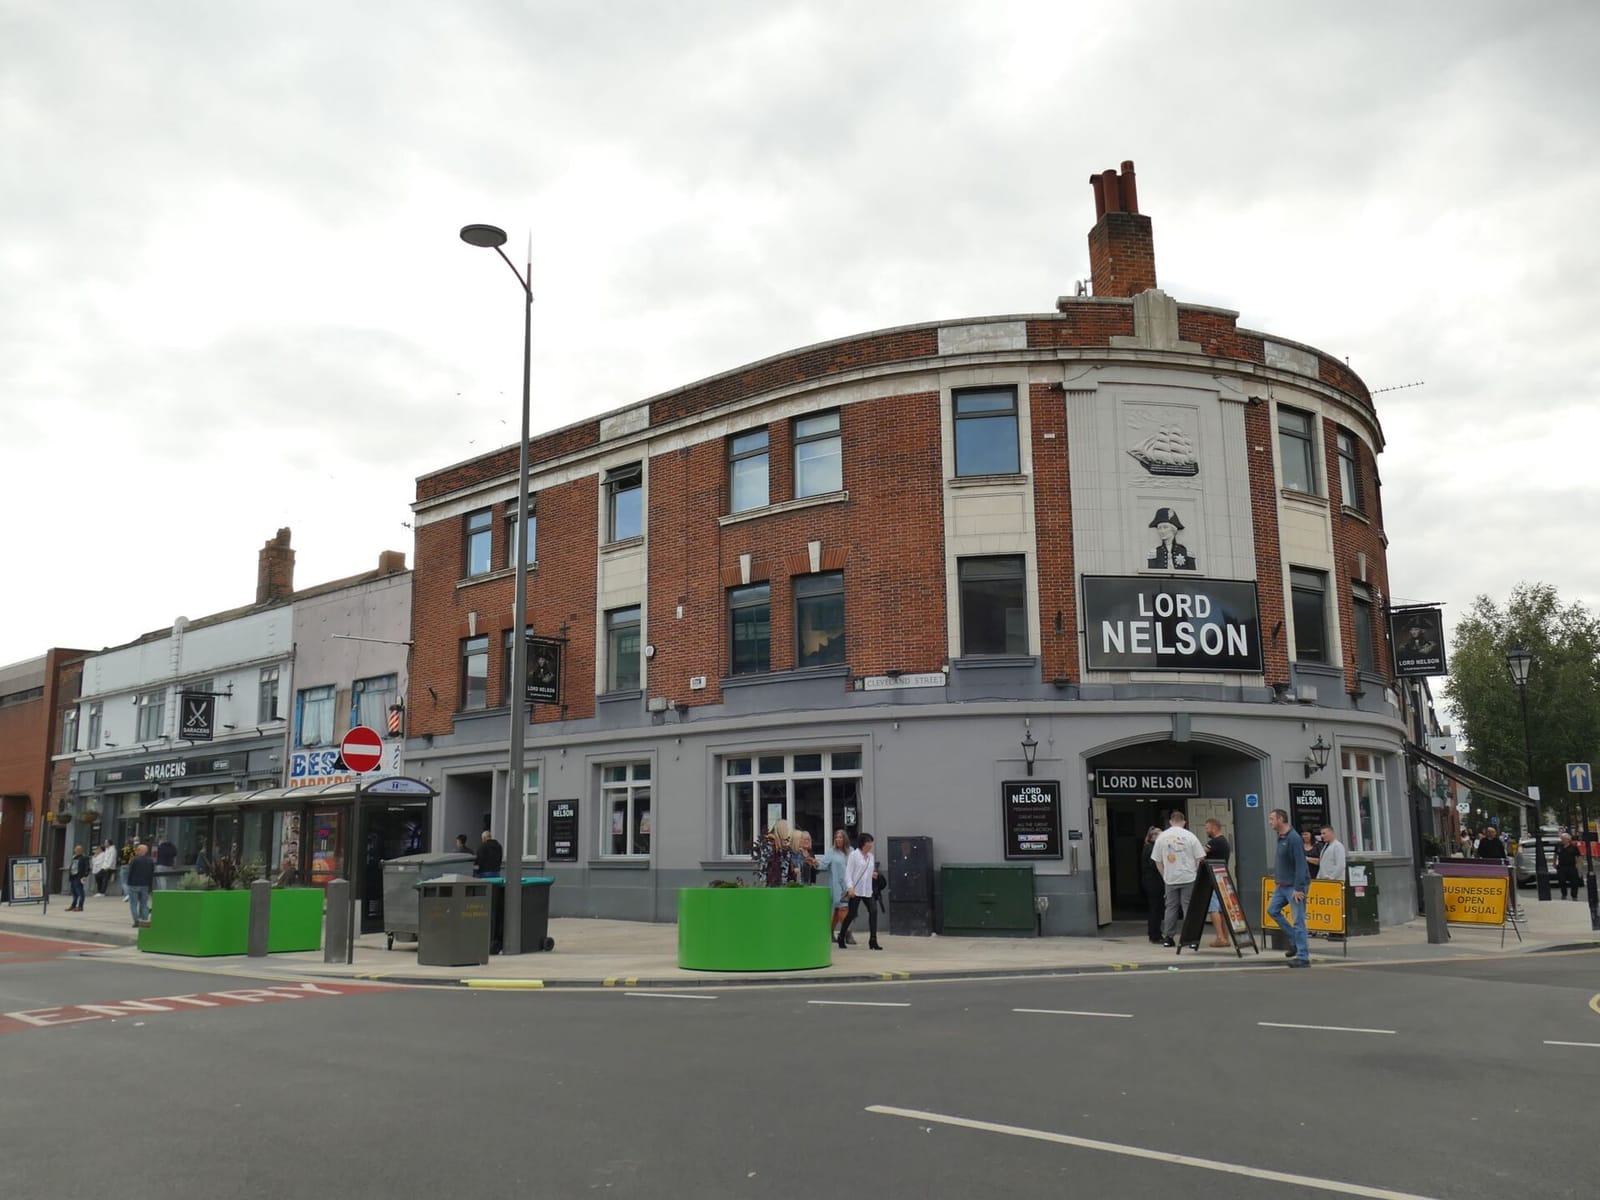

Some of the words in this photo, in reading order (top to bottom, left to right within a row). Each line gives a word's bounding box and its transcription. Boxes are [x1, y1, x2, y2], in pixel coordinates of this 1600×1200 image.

[1138, 593, 1211, 618] LORD
[1102, 620, 1248, 657] NELSON
[866, 678, 910, 688] CLEVELAND
[915, 676, 944, 685] STREET
[291, 751, 348, 777] BES
[144, 762, 186, 780] SARACENS
[1102, 776, 1137, 788] LORD
[1142, 776, 1193, 788] NELSON
[1012, 794, 1051, 803] NELSON
[1296, 796, 1323, 805] NELSON
[553, 809, 574, 817] NELSON
[1442, 886, 1502, 896] BUSINESSES
[1457, 895, 1485, 904] OPEN
[1444, 904, 1456, 913] AS
[1464, 906, 1497, 915] USUAL
[3, 983, 343, 1026] ENTRY
